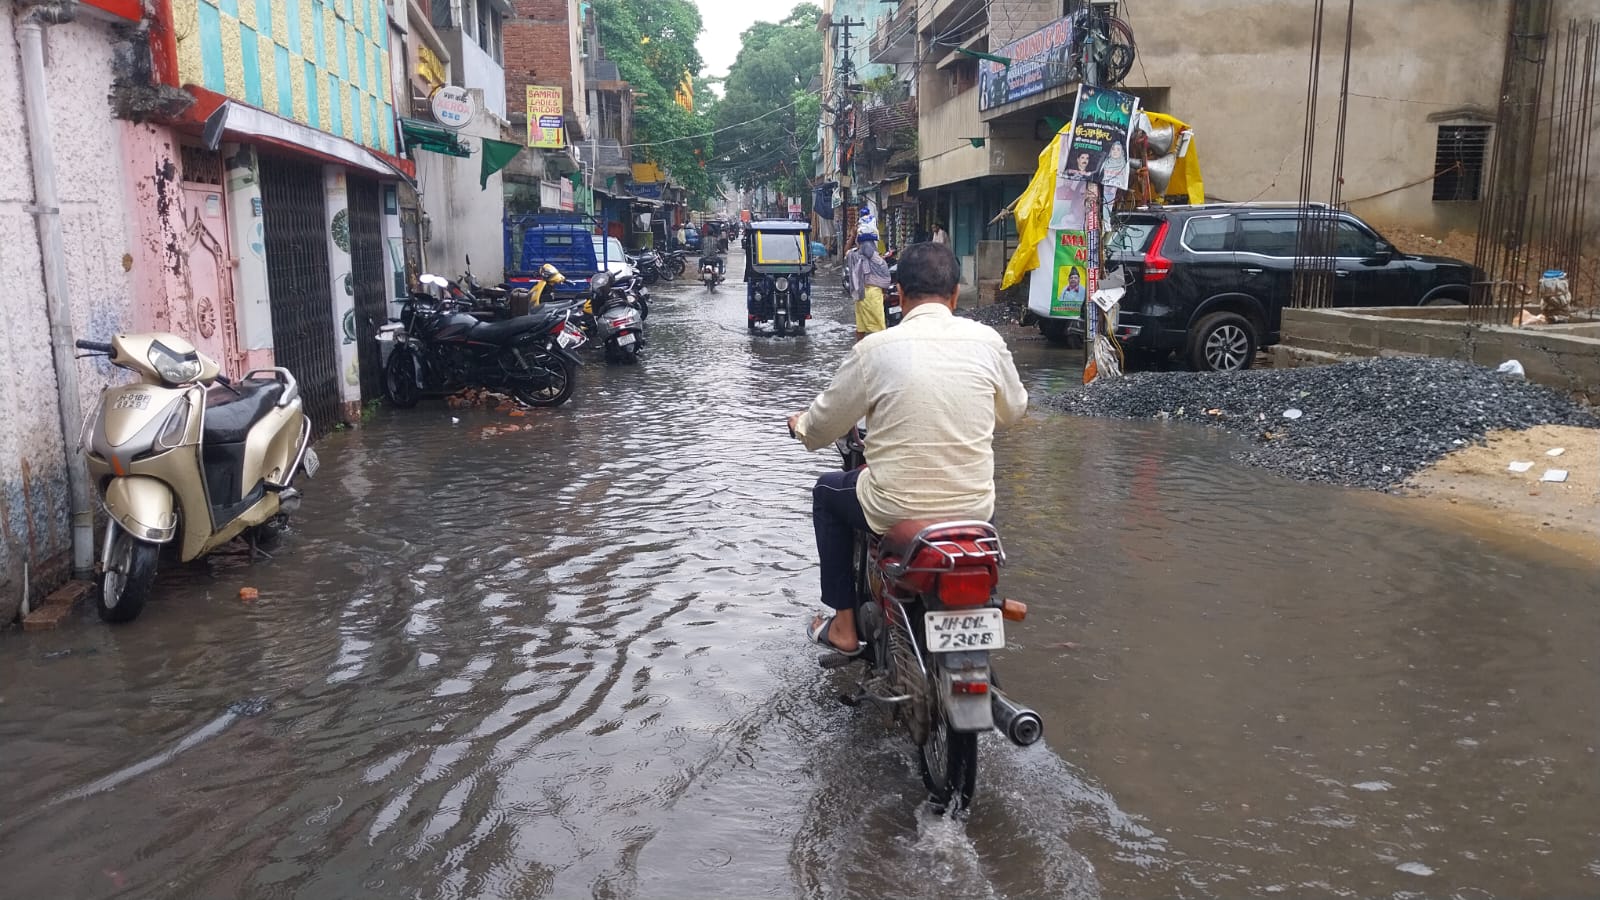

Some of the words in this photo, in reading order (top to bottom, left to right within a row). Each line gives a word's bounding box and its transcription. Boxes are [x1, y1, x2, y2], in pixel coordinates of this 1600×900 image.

[1015, 31, 1043, 61] SOUND
[1053, 19, 1069, 48] DJ
[528, 89, 560, 99] SAMRIN
[437, 99, 471, 114] XEROX
[530, 98, 558, 106] LADIES
[528, 105, 561, 114] TAILORS
[441, 110, 461, 121] CSC
